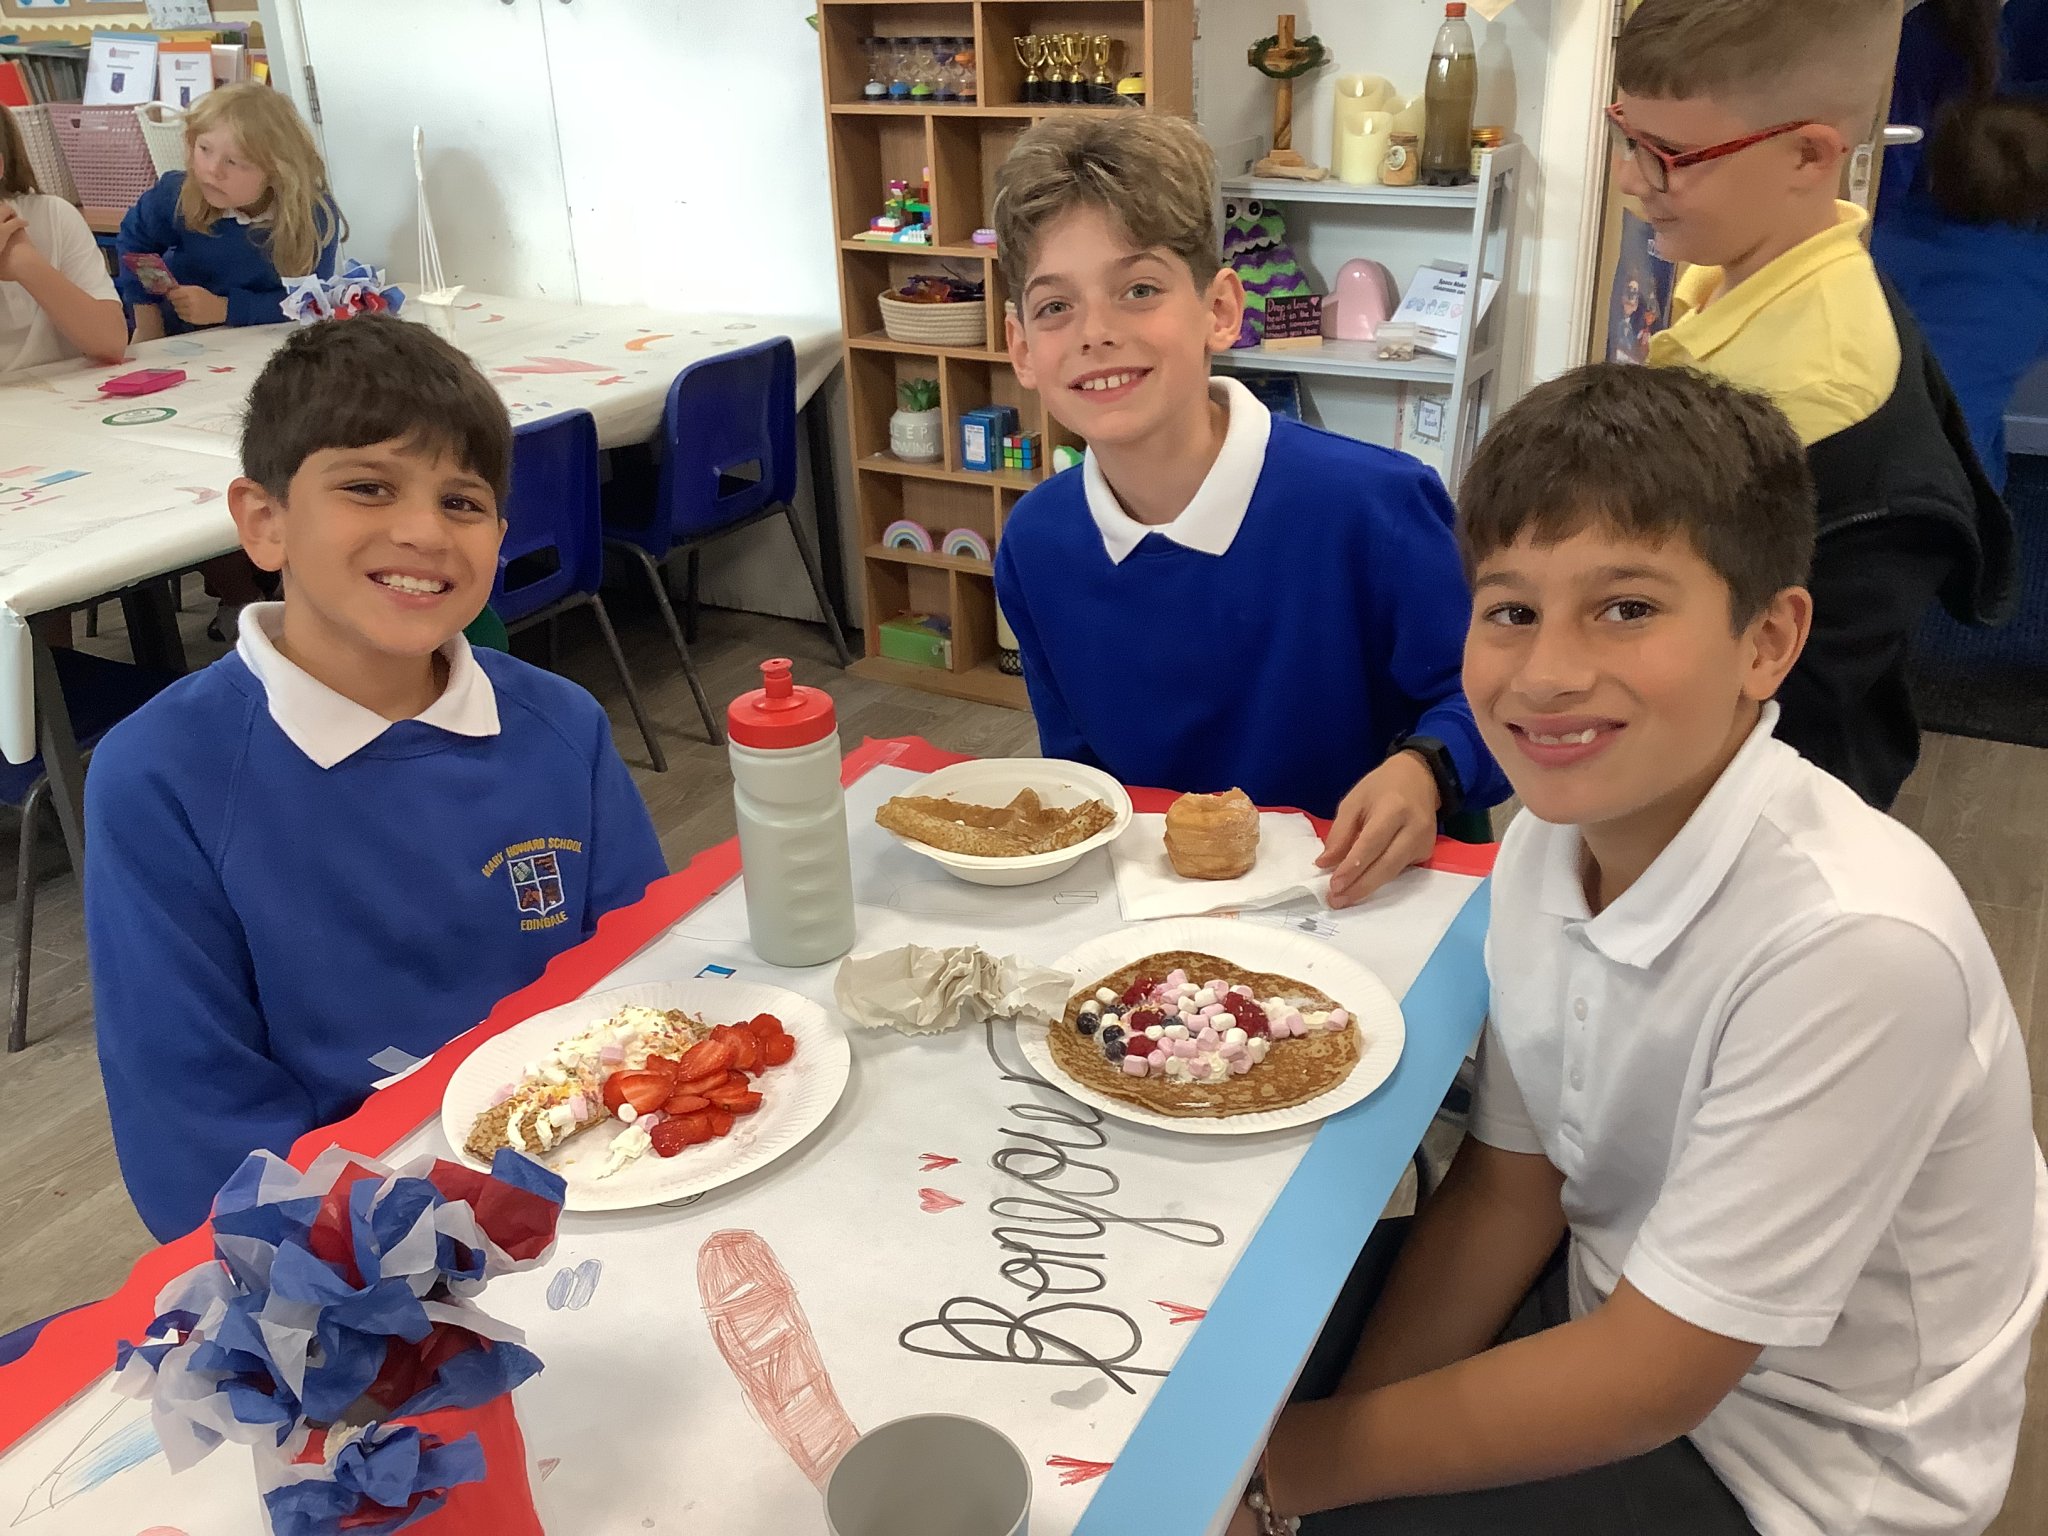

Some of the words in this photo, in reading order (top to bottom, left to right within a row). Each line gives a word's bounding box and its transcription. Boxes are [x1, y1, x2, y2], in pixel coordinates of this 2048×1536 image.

[1267, 298, 1285, 312] Drop
[505, 838, 546, 858] HOWARD
[547, 837, 583, 853] SCHOOL
[520, 910, 569, 931] EDINGALE
